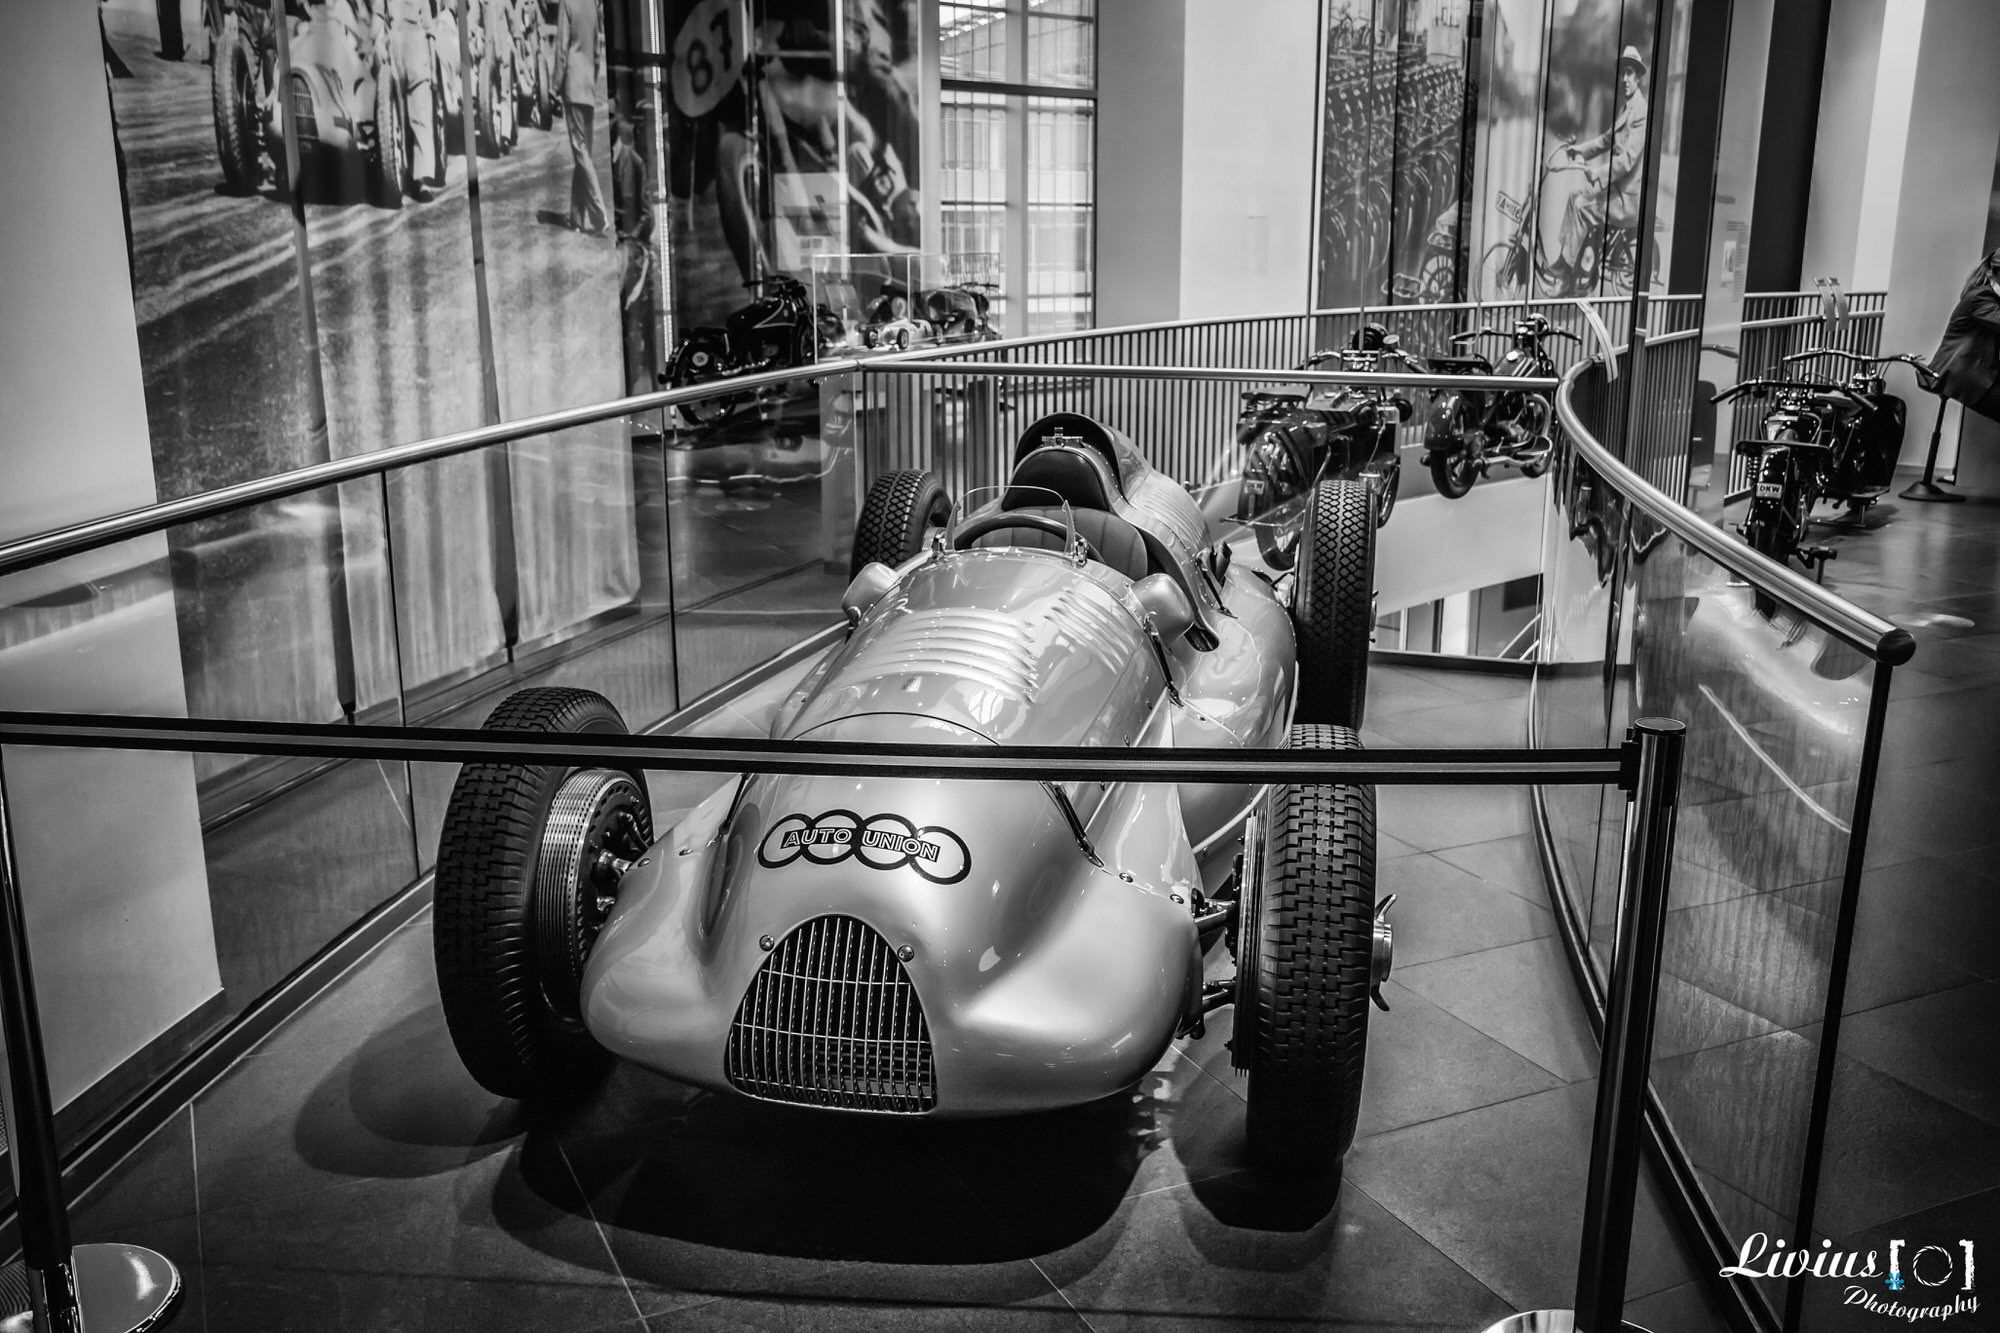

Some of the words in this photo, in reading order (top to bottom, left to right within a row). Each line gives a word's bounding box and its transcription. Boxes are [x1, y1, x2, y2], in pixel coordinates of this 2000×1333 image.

[1760, 485, 1780, 493] DKW
[783, 828, 852, 848] AUTO
[862, 830, 938, 861] UNION
